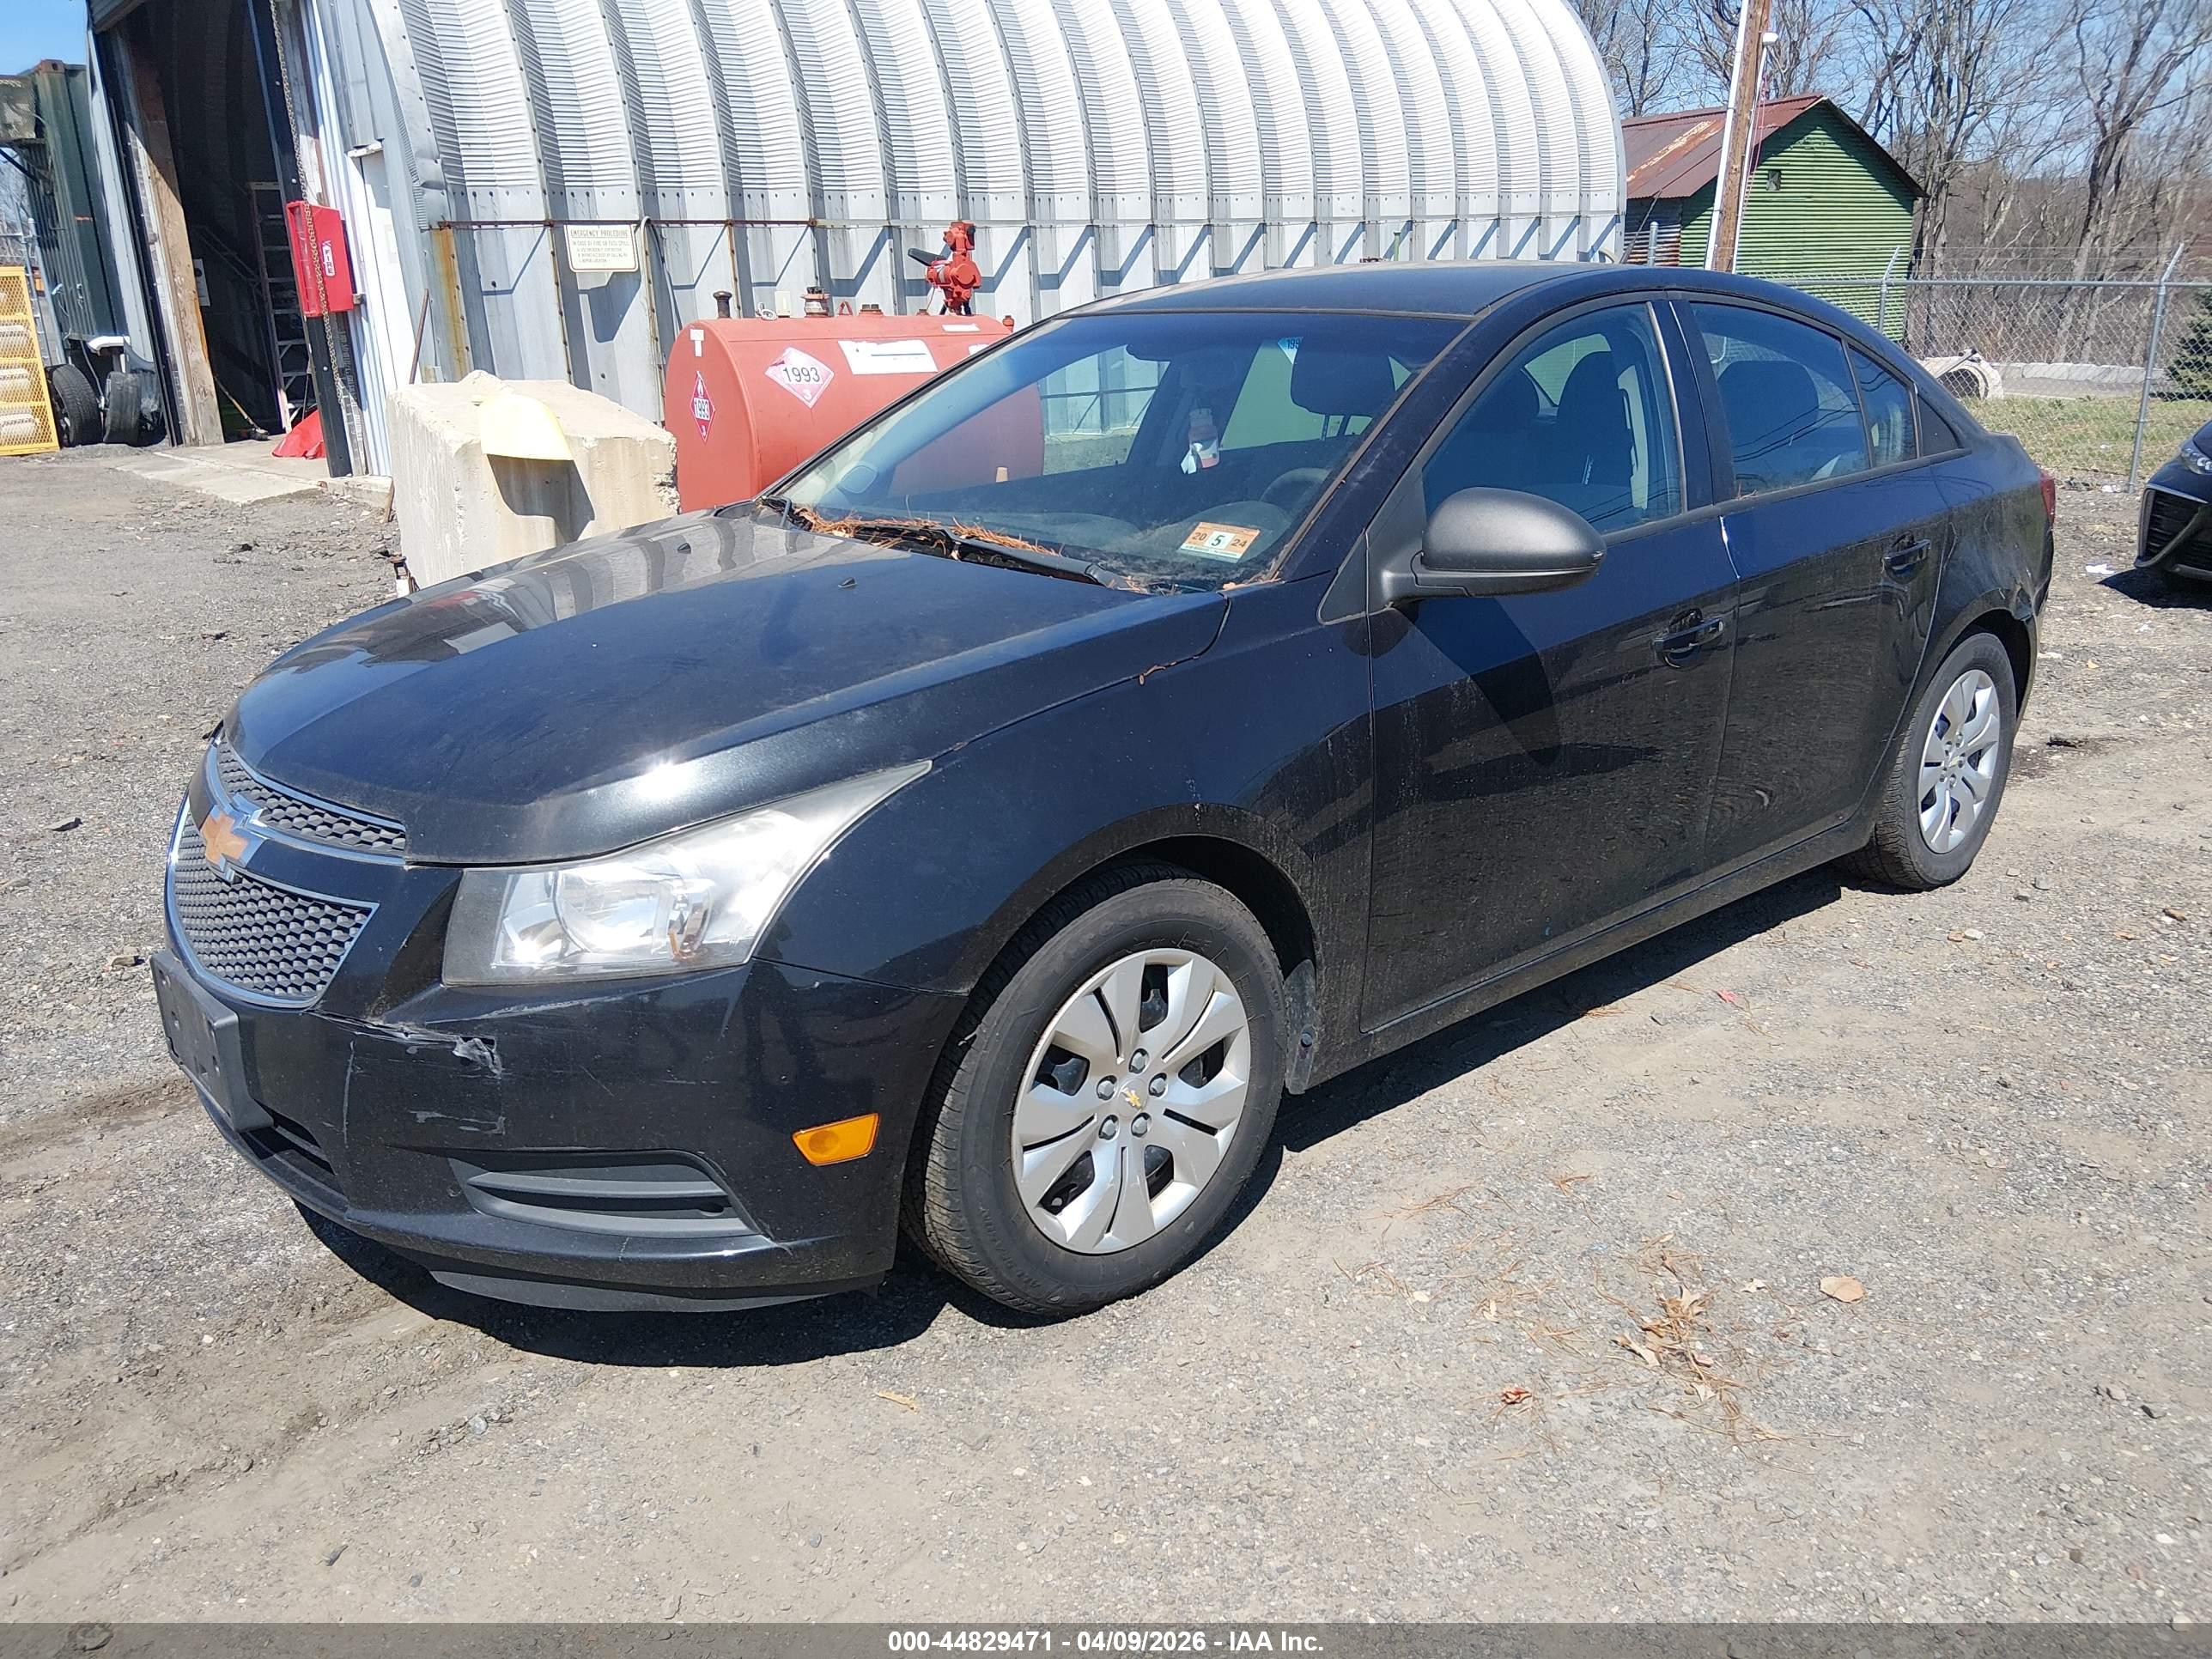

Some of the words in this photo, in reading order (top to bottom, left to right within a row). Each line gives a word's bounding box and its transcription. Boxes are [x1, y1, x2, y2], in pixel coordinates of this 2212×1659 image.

[325, 249, 333, 273] FIRE
[782, 366, 821, 383] 1993
[802, 389, 812, 400] 3
[694, 399, 709, 418] 1993
[1192, 532, 1207, 541] 20
[1211, 535, 1225, 546] 5
[1231, 538, 1248, 547] 24
